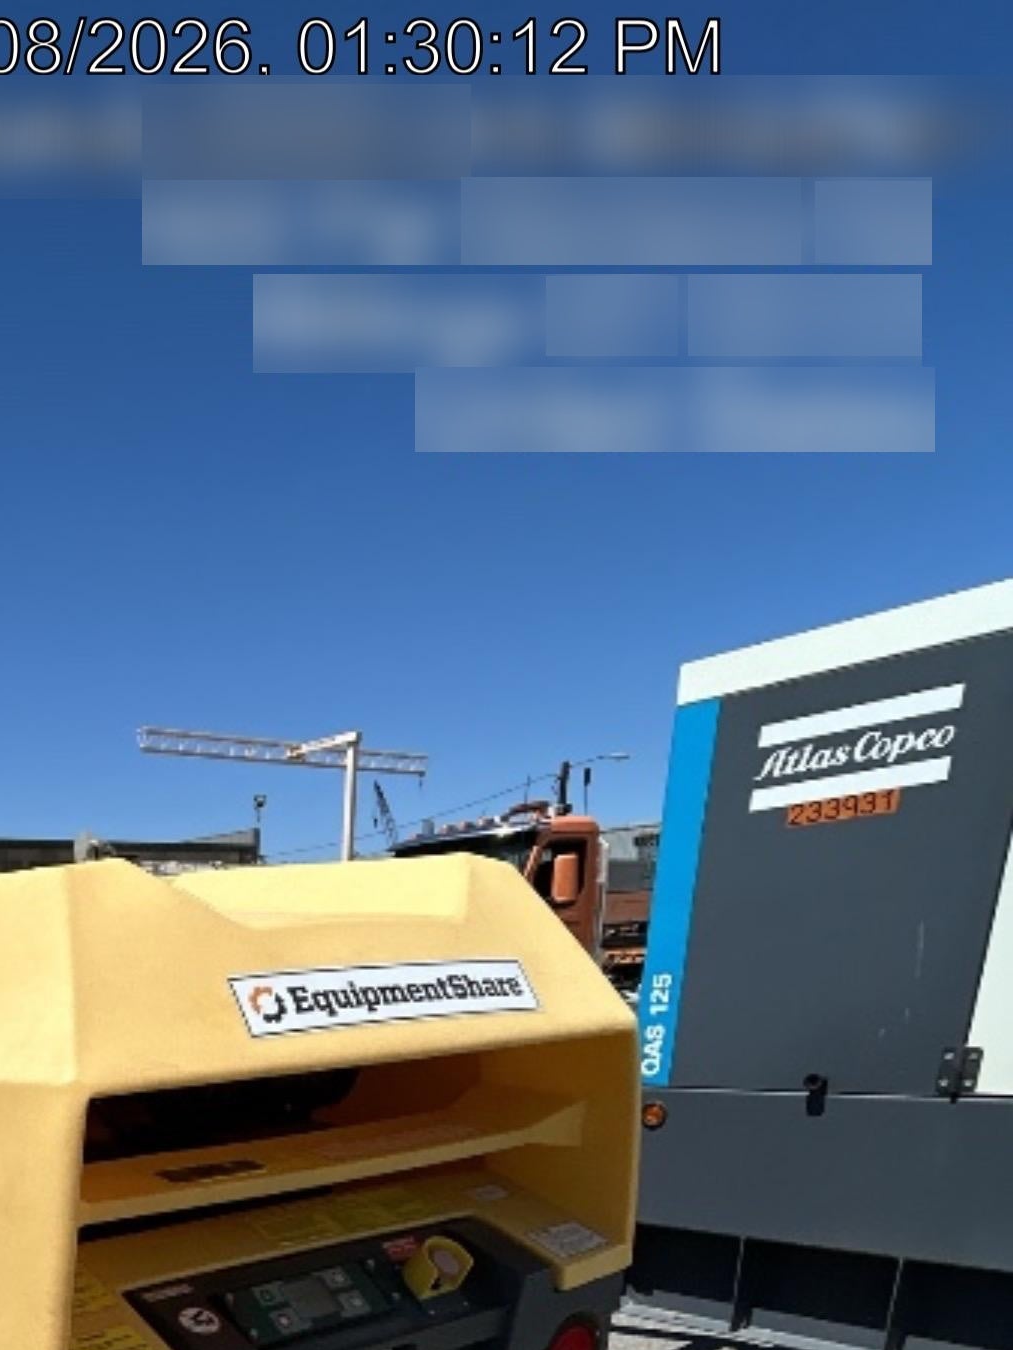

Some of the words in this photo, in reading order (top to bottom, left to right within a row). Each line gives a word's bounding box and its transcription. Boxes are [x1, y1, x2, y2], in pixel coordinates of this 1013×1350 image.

[753, 743, 850, 781] Atlas
[854, 725, 955, 763] Copco
[287, 974, 523, 1017] EquipmentShare
[649, 973, 673, 1016] 125
[640, 1024, 666, 1076] QAS
